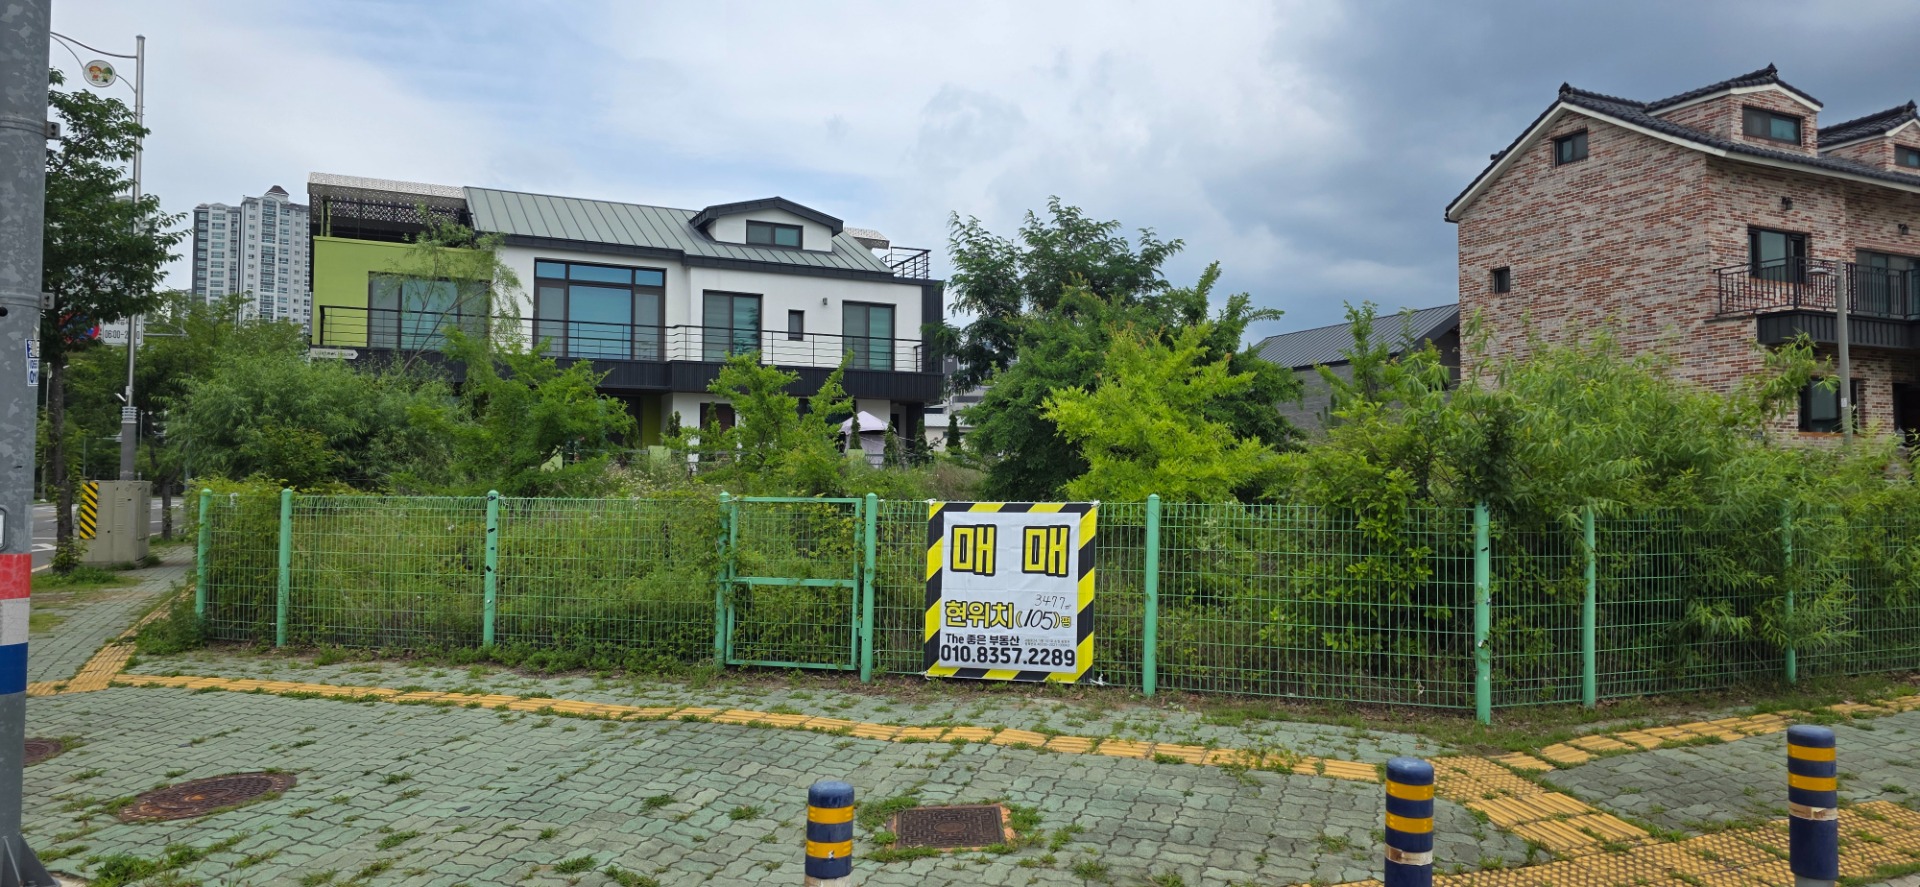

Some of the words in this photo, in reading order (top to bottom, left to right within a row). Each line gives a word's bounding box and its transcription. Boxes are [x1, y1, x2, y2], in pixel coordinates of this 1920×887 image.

[951, 524, 997, 576] 매
[1022, 525, 1070, 577] 매
[945, 633, 964, 644] The
[989, 635, 1020, 646] 부동산
[940, 644, 1076, 666] 010.8357.2289
